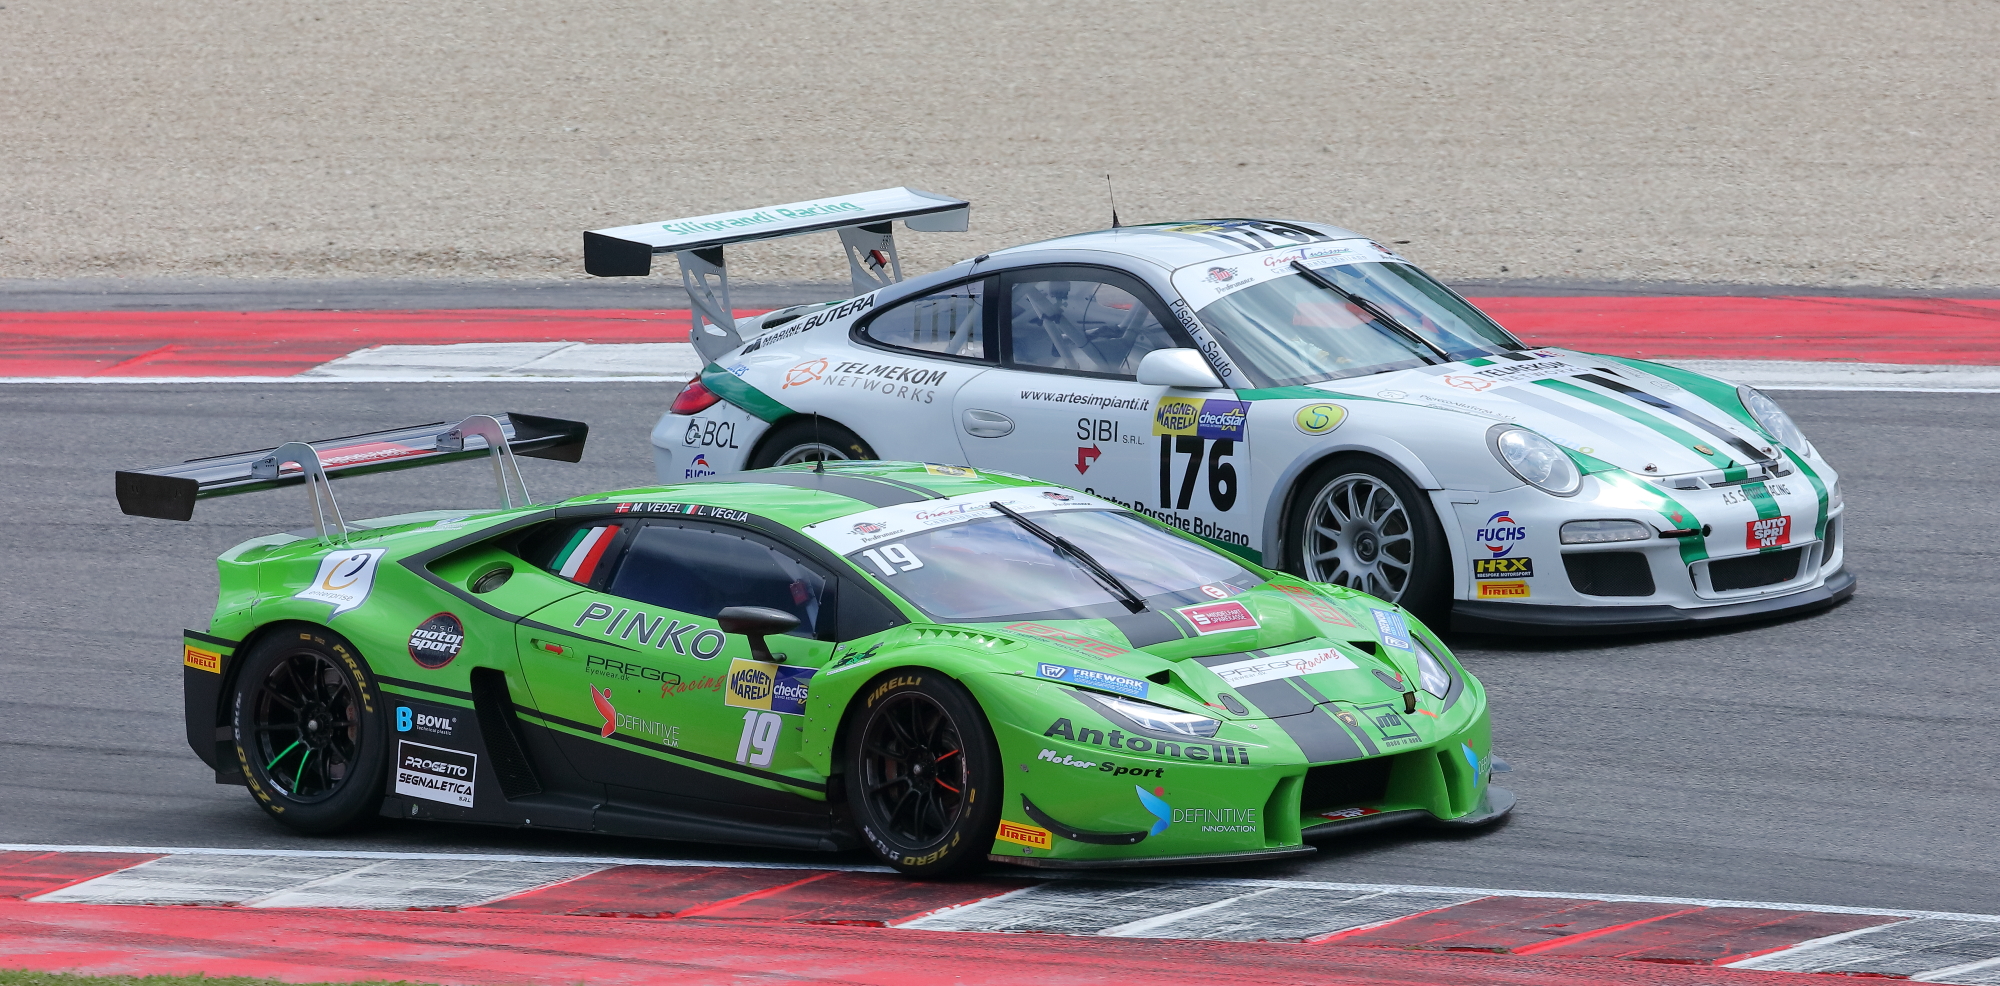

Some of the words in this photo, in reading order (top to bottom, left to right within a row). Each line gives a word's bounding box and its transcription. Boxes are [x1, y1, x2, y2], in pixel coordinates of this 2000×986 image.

[662, 211, 776, 237] Siliprandi
[776, 200, 866, 219] Racing
[802, 293, 875, 333] BUTERA
[1170, 298, 1205, 337] Pisani
[1203, 341, 1232, 378] Sauto
[834, 361, 947, 387] TELMEKOM
[823, 375, 936, 404] NETWORKS
[1020, 389, 1150, 411] www.artesimpianti.it
[1157, 402, 1198, 418] MAGNETI
[1198, 411, 1245, 426] checkstar
[1076, 417, 1119, 443] SIBI
[1122, 434, 1145, 445] S.R.L.
[1157, 413, 1197, 430] MARELLI
[701, 421, 739, 449] BCL
[1159, 433, 1237, 512] 176
[1722, 491, 1741, 505] A.S.
[1763, 484, 1791, 498] RACING
[631, 502, 643, 512] M.
[646, 503, 681, 514] VEDEL
[698, 505, 708, 516] L.
[709, 507, 749, 523] VEGLIA
[1193, 516, 1249, 547] Bolzano
[1476, 525, 1526, 542] FUCHS
[1752, 517, 1786, 531] AUTO
[1754, 526, 1784, 539] SPRI
[1761, 536, 1777, 547] NT
[862, 543, 924, 577] 19
[1477, 558, 1528, 573] HRX
[309, 590, 354, 602] enterprise
[1482, 583, 1525, 596] PIRELLI
[411, 628, 464, 644] motor
[573, 601, 727, 661] PINKO
[409, 637, 461, 654] sport
[187, 650, 217, 669] PIRELLI
[1217, 658, 1307, 679] PREGO
[1296, 648, 1340, 674] Racing
[333, 643, 374, 713] PIRELLI
[585, 666, 630, 683] Eyewear.dk
[586, 654, 681, 685] PREGO
[660, 674, 727, 699] Racing
[731, 667, 772, 686] MAGNETI
[1073, 668, 1143, 689] FREEWORK
[731, 682, 771, 701] MARELLI
[773, 682, 808, 699] checks
[867, 676, 922, 708] PIRELLI
[416, 725, 437, 733] Technical
[437, 728, 452, 736] plastic
[617, 711, 679, 740] DEFINITIVE
[735, 710, 783, 769] 19
[1043, 717, 1249, 765] Antonelli
[237, 745, 271, 803] ZERO
[404, 756, 469, 777] PROGETTO
[1037, 748, 1096, 769] Motor
[1099, 761, 1164, 780] Sport
[399, 772, 472, 797] SEGNALETICA
[1173, 808, 1256, 824] DEFINITIVE
[1000, 823, 1046, 845] PIRELLI
[1201, 825, 1256, 833] INNOVATION
[903, 847, 949, 866] ZERO
